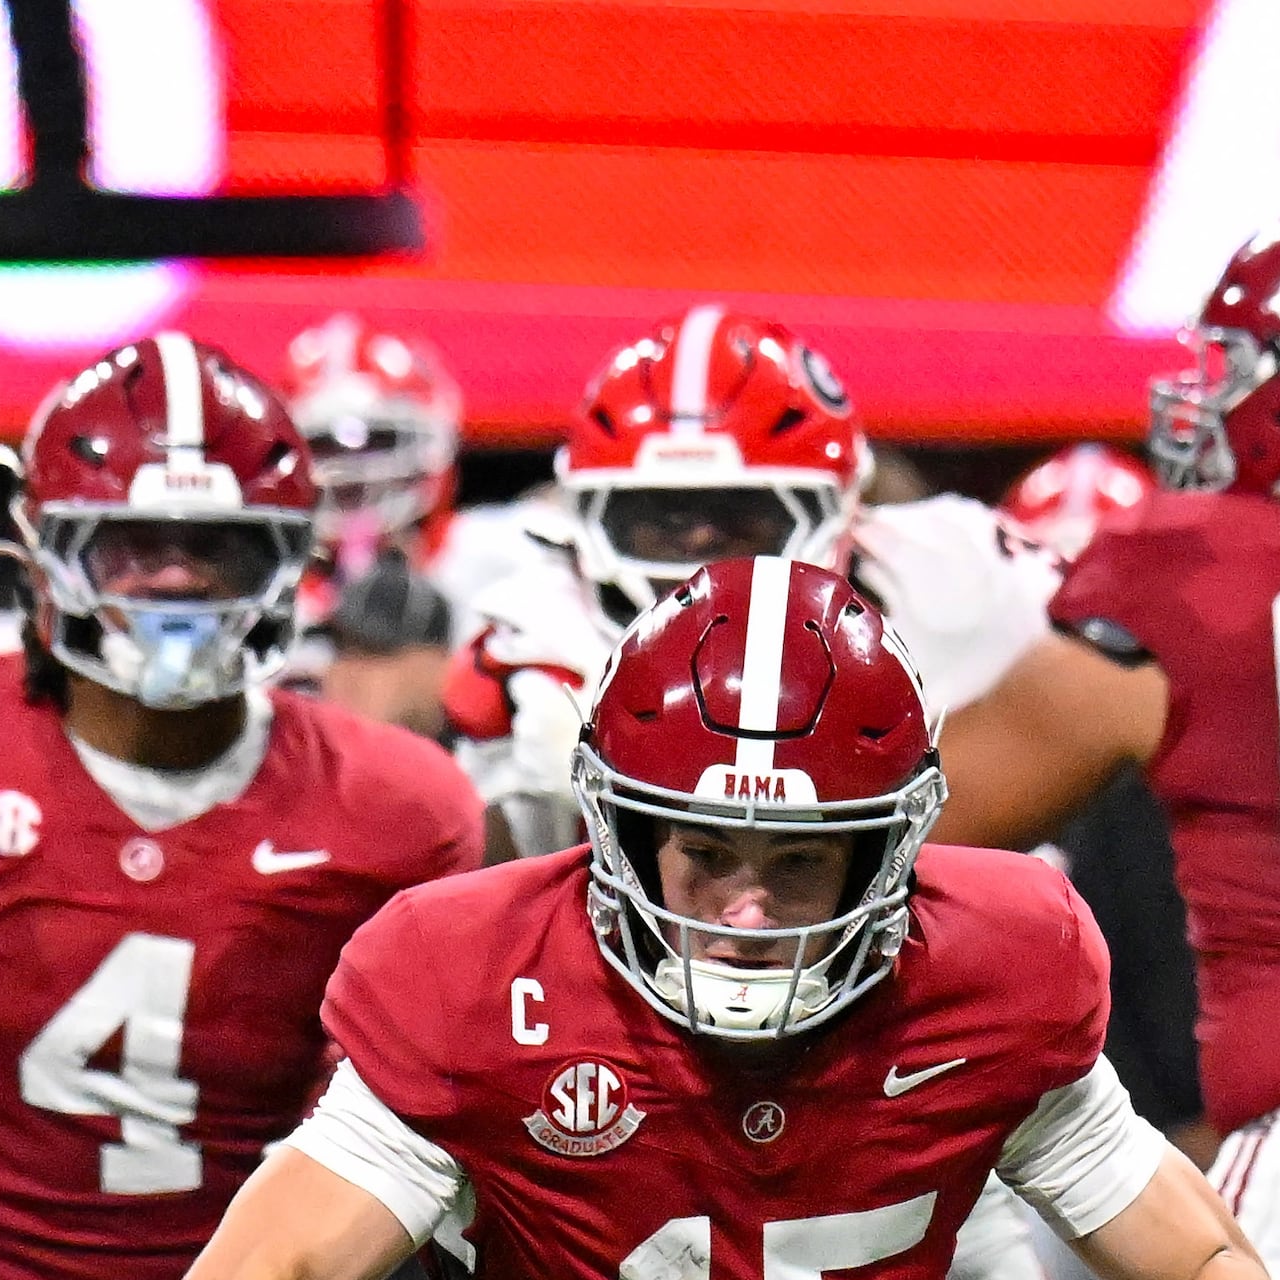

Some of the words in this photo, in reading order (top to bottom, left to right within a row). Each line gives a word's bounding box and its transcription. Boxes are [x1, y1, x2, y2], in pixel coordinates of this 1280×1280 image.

[724, 773, 787, 802] BAMA
[511, 976, 549, 1046] C
[20, 931, 202, 1195] 4
[550, 1062, 621, 1132] SEC
[538, 1126, 628, 1153] GRADUATE
